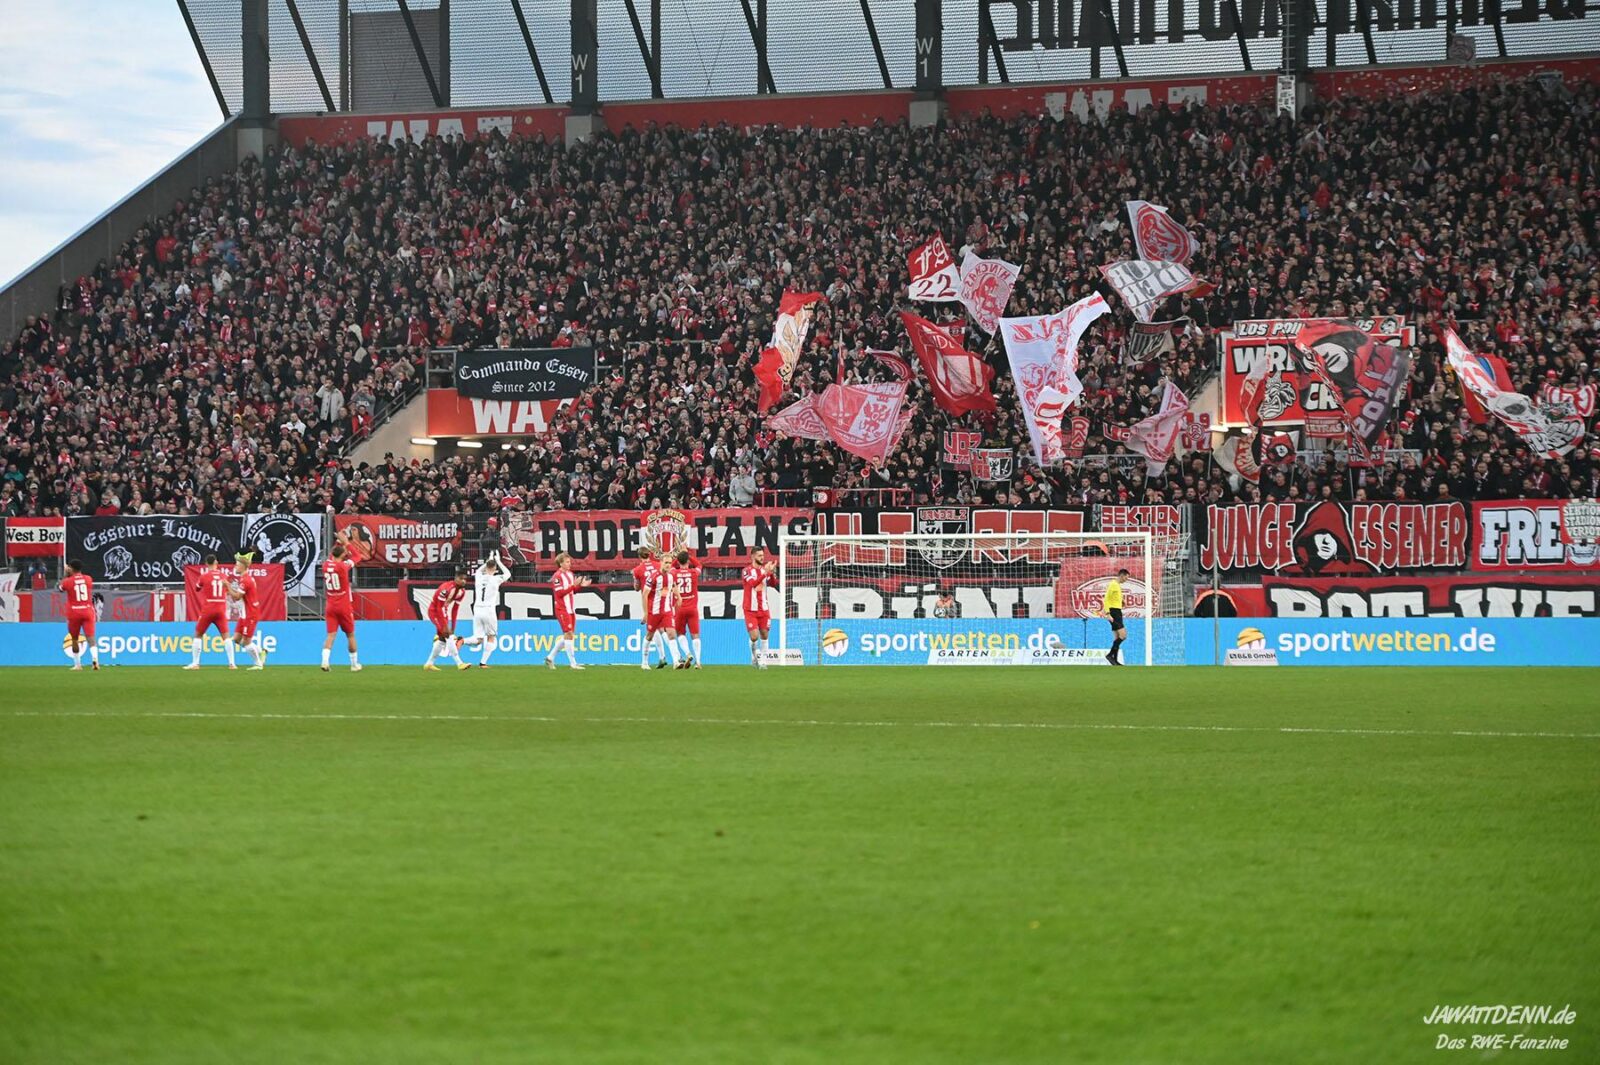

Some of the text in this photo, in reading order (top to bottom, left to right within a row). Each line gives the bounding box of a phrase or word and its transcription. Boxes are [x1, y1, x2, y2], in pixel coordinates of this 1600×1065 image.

[917, 37, 934, 54] W
[571, 54, 588, 70] W
[920, 58, 928, 77] 1
[575, 74, 583, 93] 1
[917, 274, 957, 298] 22
[1240, 323, 1268, 335] LOS
[458, 358, 590, 383] Commando Essen
[491, 381, 556, 393] Since 2012
[1101, 504, 1181, 526] SEKTION
[6, 527, 36, 543] West
[83, 518, 222, 551] Essener Löwen
[265, 513, 294, 522] GARDE
[295, 519, 314, 543] ESSEN
[378, 522, 458, 539] HAFENSÄNGER
[1200, 502, 1468, 571] JUNGE ESSENER
[538, 516, 812, 561] RUDE FANS
[385, 542, 453, 564] ESSEN
[133, 560, 173, 578] 1980
[211, 579, 223, 597] 11
[324, 572, 341, 590] 20
[677, 577, 692, 593] 23
[73, 583, 88, 601] 19
[860, 627, 1061, 659] sportwetten.de
[1278, 627, 1496, 659] sportwetten.de
